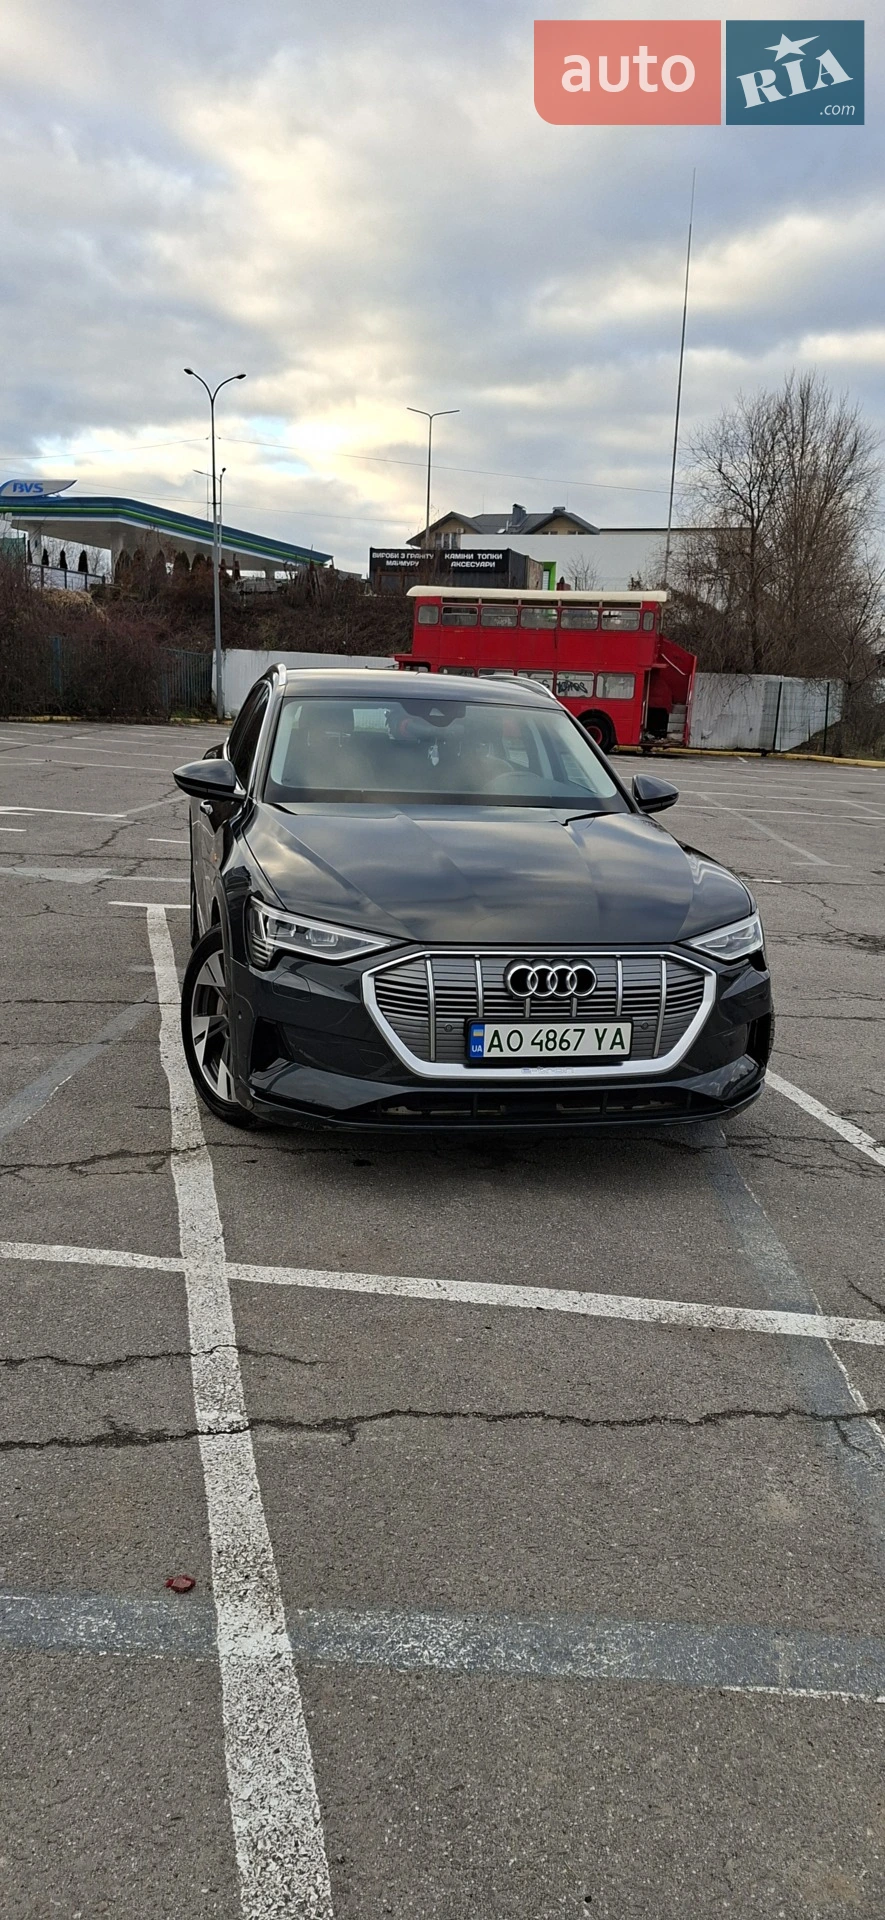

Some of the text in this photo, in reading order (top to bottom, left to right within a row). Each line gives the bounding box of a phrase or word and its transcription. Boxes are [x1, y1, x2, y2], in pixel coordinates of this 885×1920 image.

[12, 482, 44, 493] BVS
[487, 1027, 626, 1053] AO 4867 YA
[471, 1045, 483, 1053] UA
